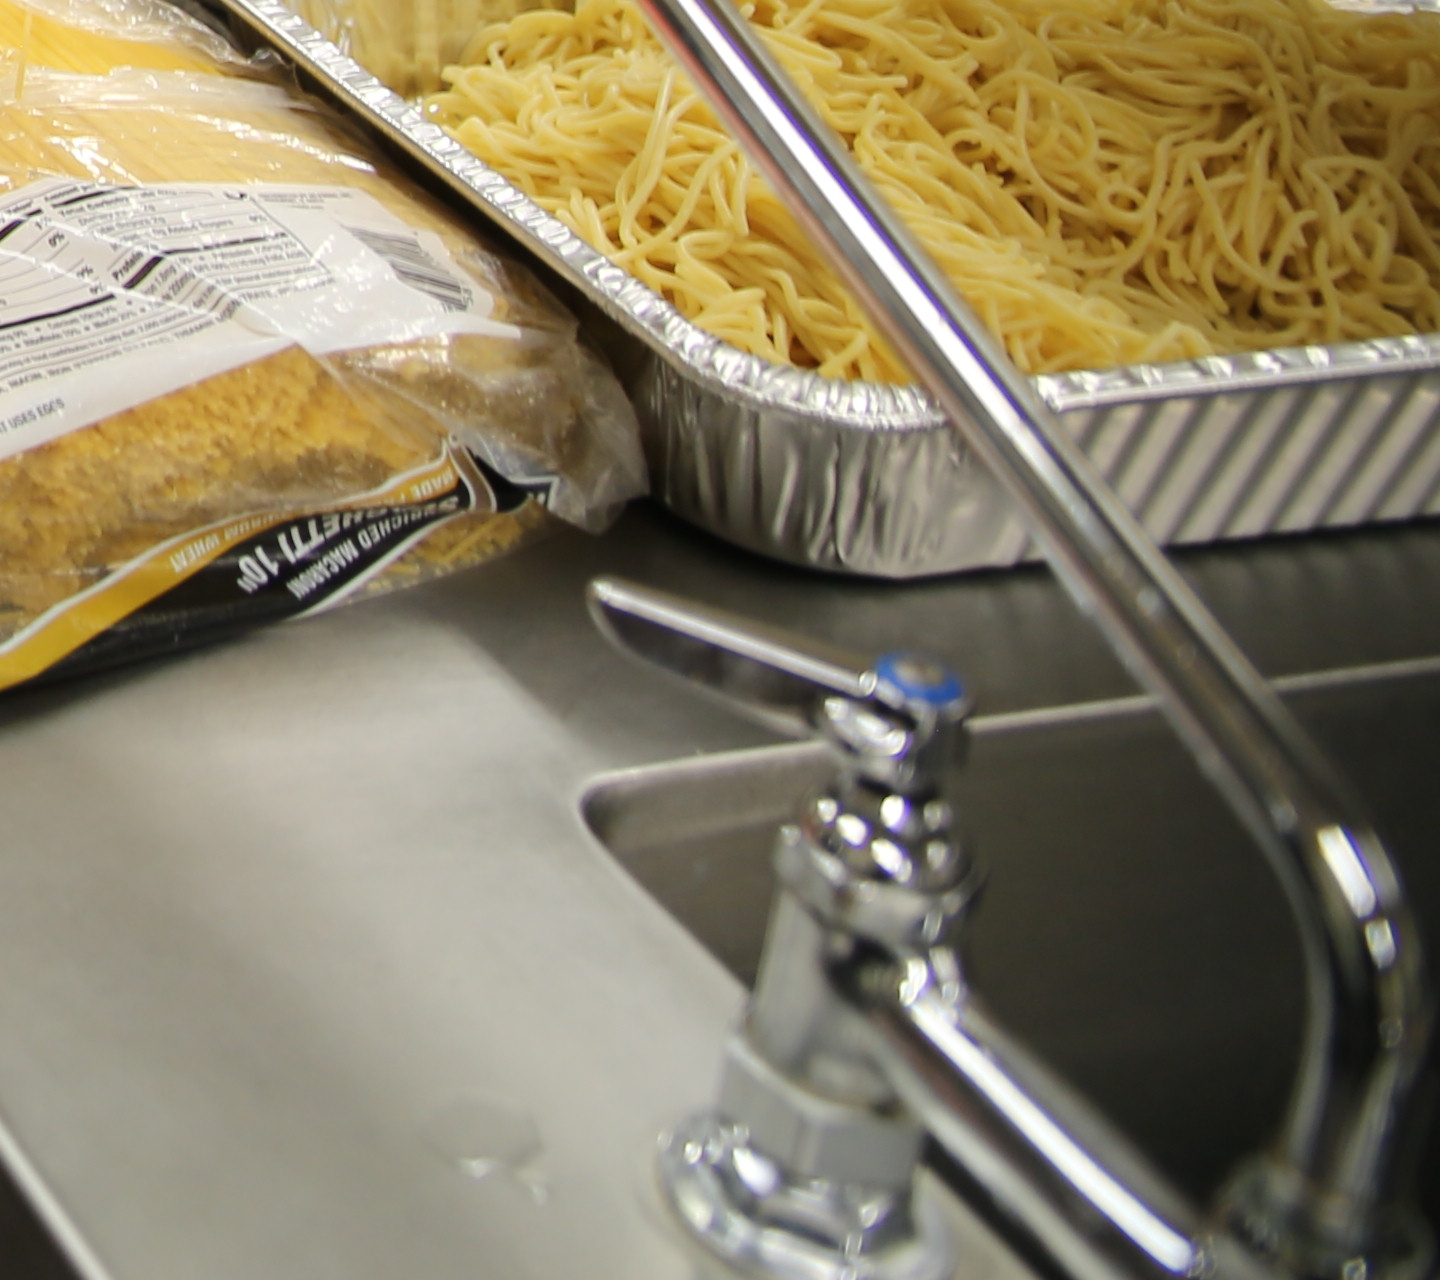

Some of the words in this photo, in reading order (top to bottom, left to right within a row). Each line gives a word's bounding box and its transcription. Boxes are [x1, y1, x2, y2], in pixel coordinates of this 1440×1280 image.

[48, 231, 66, 247] 0%
[111, 250, 145, 281] Protein
[8, 410, 38, 429] USES
[411, 466, 454, 500] MADE
[357, 496, 458, 550] NRICHED
[168, 532, 221, 574] WHEAT
[236, 545, 280, 594] 10"
[285, 538, 360, 601] MACARONI
